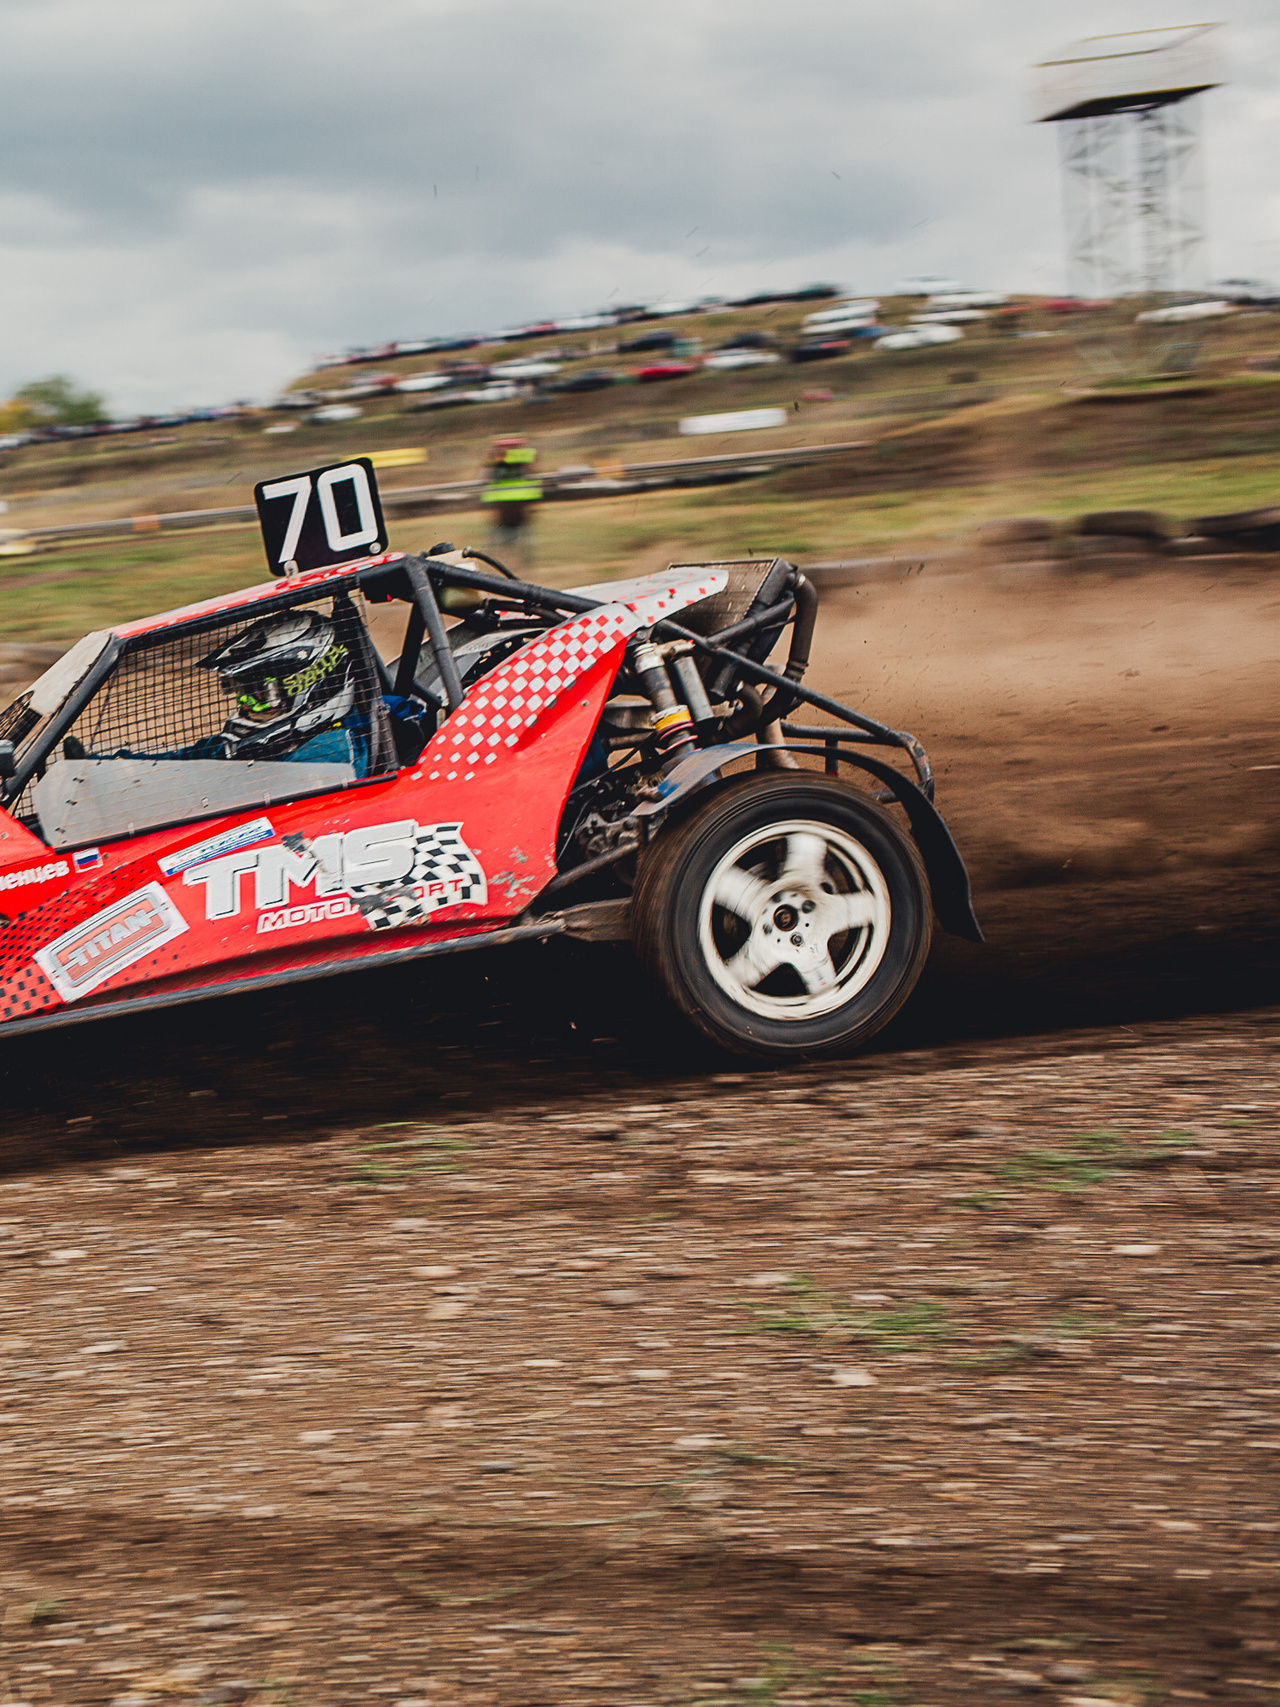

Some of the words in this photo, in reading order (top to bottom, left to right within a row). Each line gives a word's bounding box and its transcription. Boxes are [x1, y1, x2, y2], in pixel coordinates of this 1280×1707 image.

[262, 463, 379, 563] 70
[182, 818, 419, 921] TMS
[67, 908, 153, 967] TITAN
